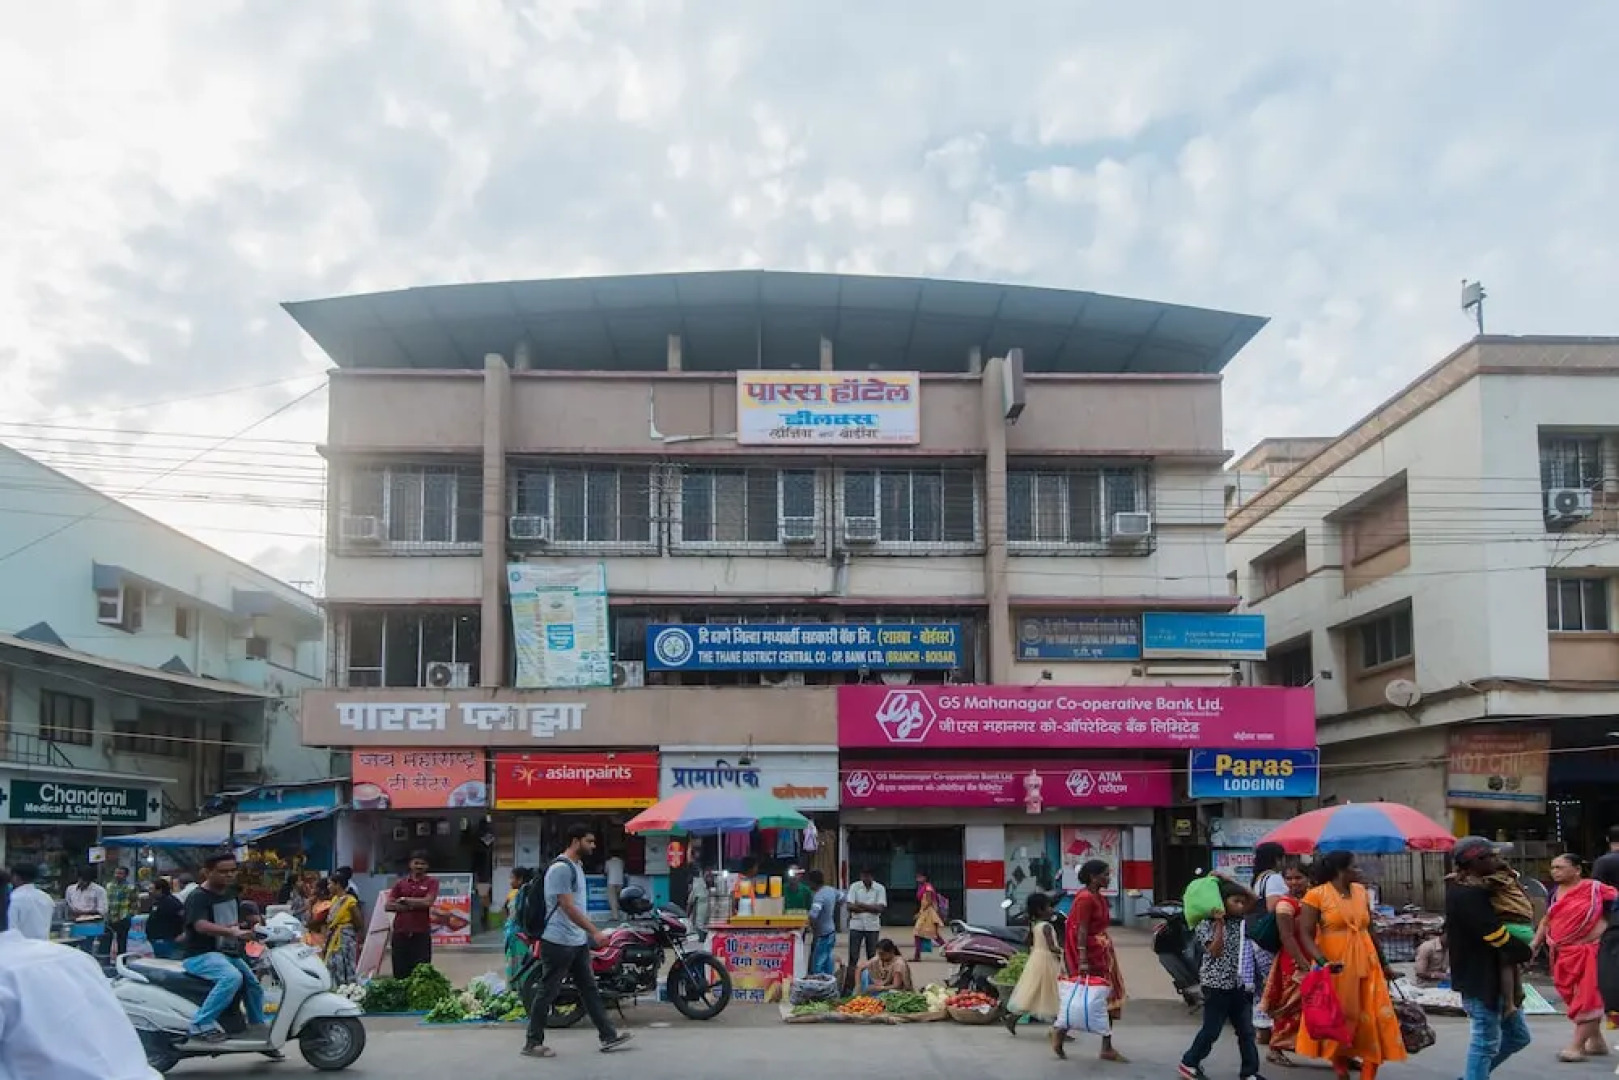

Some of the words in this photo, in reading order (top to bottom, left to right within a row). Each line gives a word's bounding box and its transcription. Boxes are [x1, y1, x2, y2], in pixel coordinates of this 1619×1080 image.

[743, 382, 824, 402] पारस
[829, 379, 909, 403] हॉटेल
[698, 651, 713, 663] THE
[715, 651, 741, 663] THANE
[743, 651, 777, 664] DISTRICT
[779, 651, 814, 663] CENTRAL
[845, 651, 866, 663] BANK
[938, 697, 960, 710] GS
[964, 696, 1052, 712] Mahanagar
[1056, 696, 1152, 713] Co-operative
[1156, 697, 1194, 710] Bank
[1197, 697, 1224, 710] Ltd.
[337, 703, 450, 730] पारस
[458, 703, 587, 738] प्लाझा
[983, 719, 1036, 733] महानगर
[1126, 716, 1147, 733] बँक
[1150, 717, 1200, 733] लिमिटेड
[360, 754, 394, 766] जय
[403, 751, 476, 772] महाराष्ट्र
[1215, 754, 1294, 777] Paras
[1451, 752, 1484, 773] HOT
[388, 773, 407, 790] टी
[412, 772, 450, 790] सेंटर
[546, 765, 632, 786] asianpaints
[672, 759, 761, 788] प्रामाणिक
[889, 773, 931, 781] Mahanagar
[1098, 772, 1123, 782] ATM
[1223, 778, 1285, 791] LODGING
[39, 783, 127, 806] Chandrani
[24, 803, 63, 814] Medical
[64, 806, 72, 814] &
[74, 805, 109, 815] Geneal
[111, 807, 138, 817] Stores
[726, 939, 738, 953] 10
